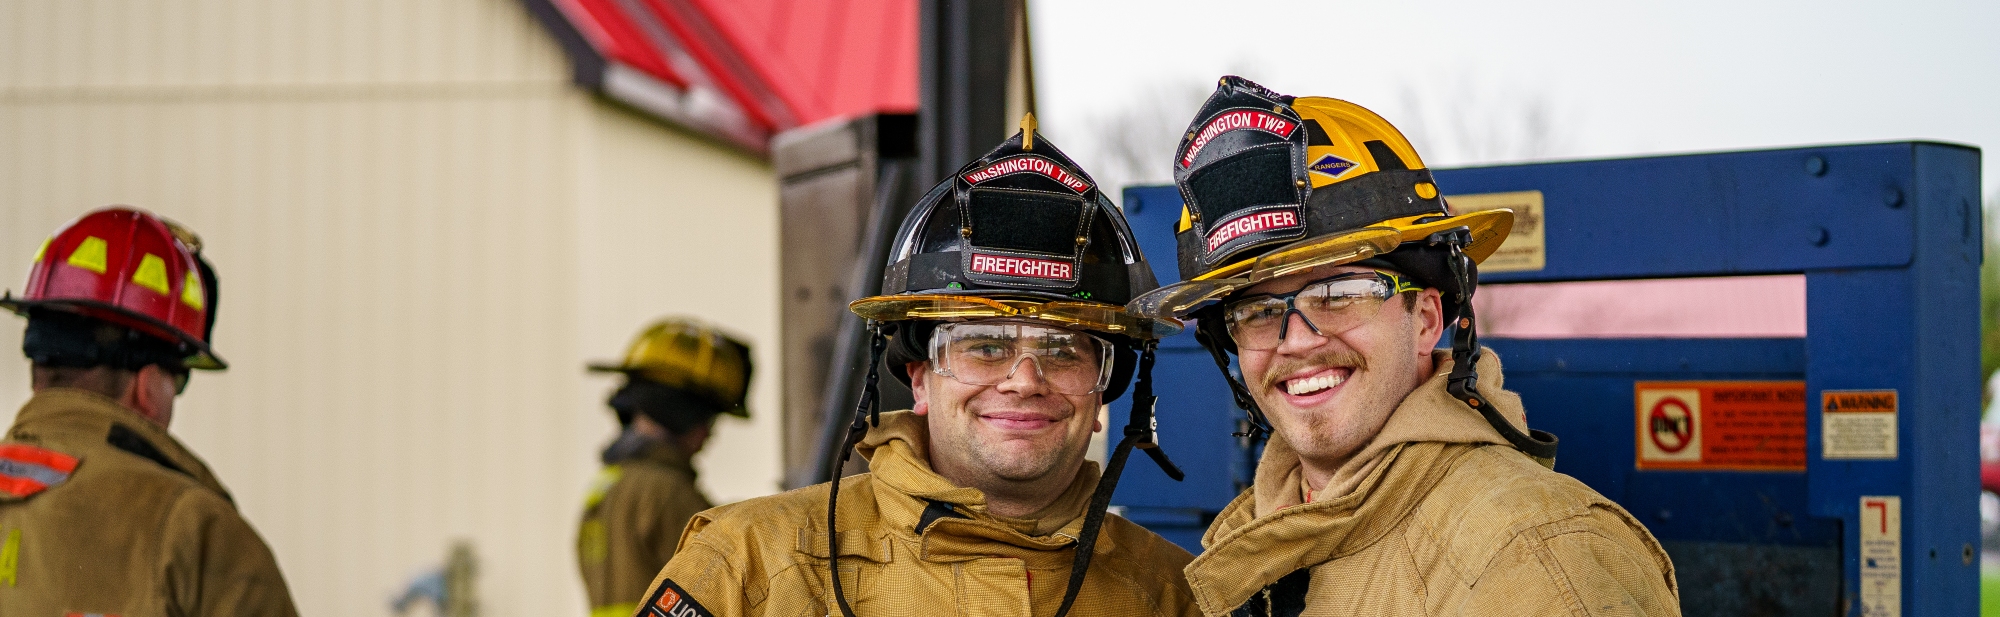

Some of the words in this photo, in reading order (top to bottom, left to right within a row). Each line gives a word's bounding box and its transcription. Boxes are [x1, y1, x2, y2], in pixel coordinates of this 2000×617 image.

[1185, 112, 1252, 163] WASHINGTON
[1256, 113, 1286, 134] TWP.
[970, 158, 1054, 182] WASHINGTON
[1314, 161, 1351, 171] RANGERS
[1208, 211, 1295, 252] FIREFIGHTER
[973, 256, 1070, 278] FIREFIGHTER
[1840, 395, 1894, 410] WARNING
[669, 598, 703, 617] LIO
